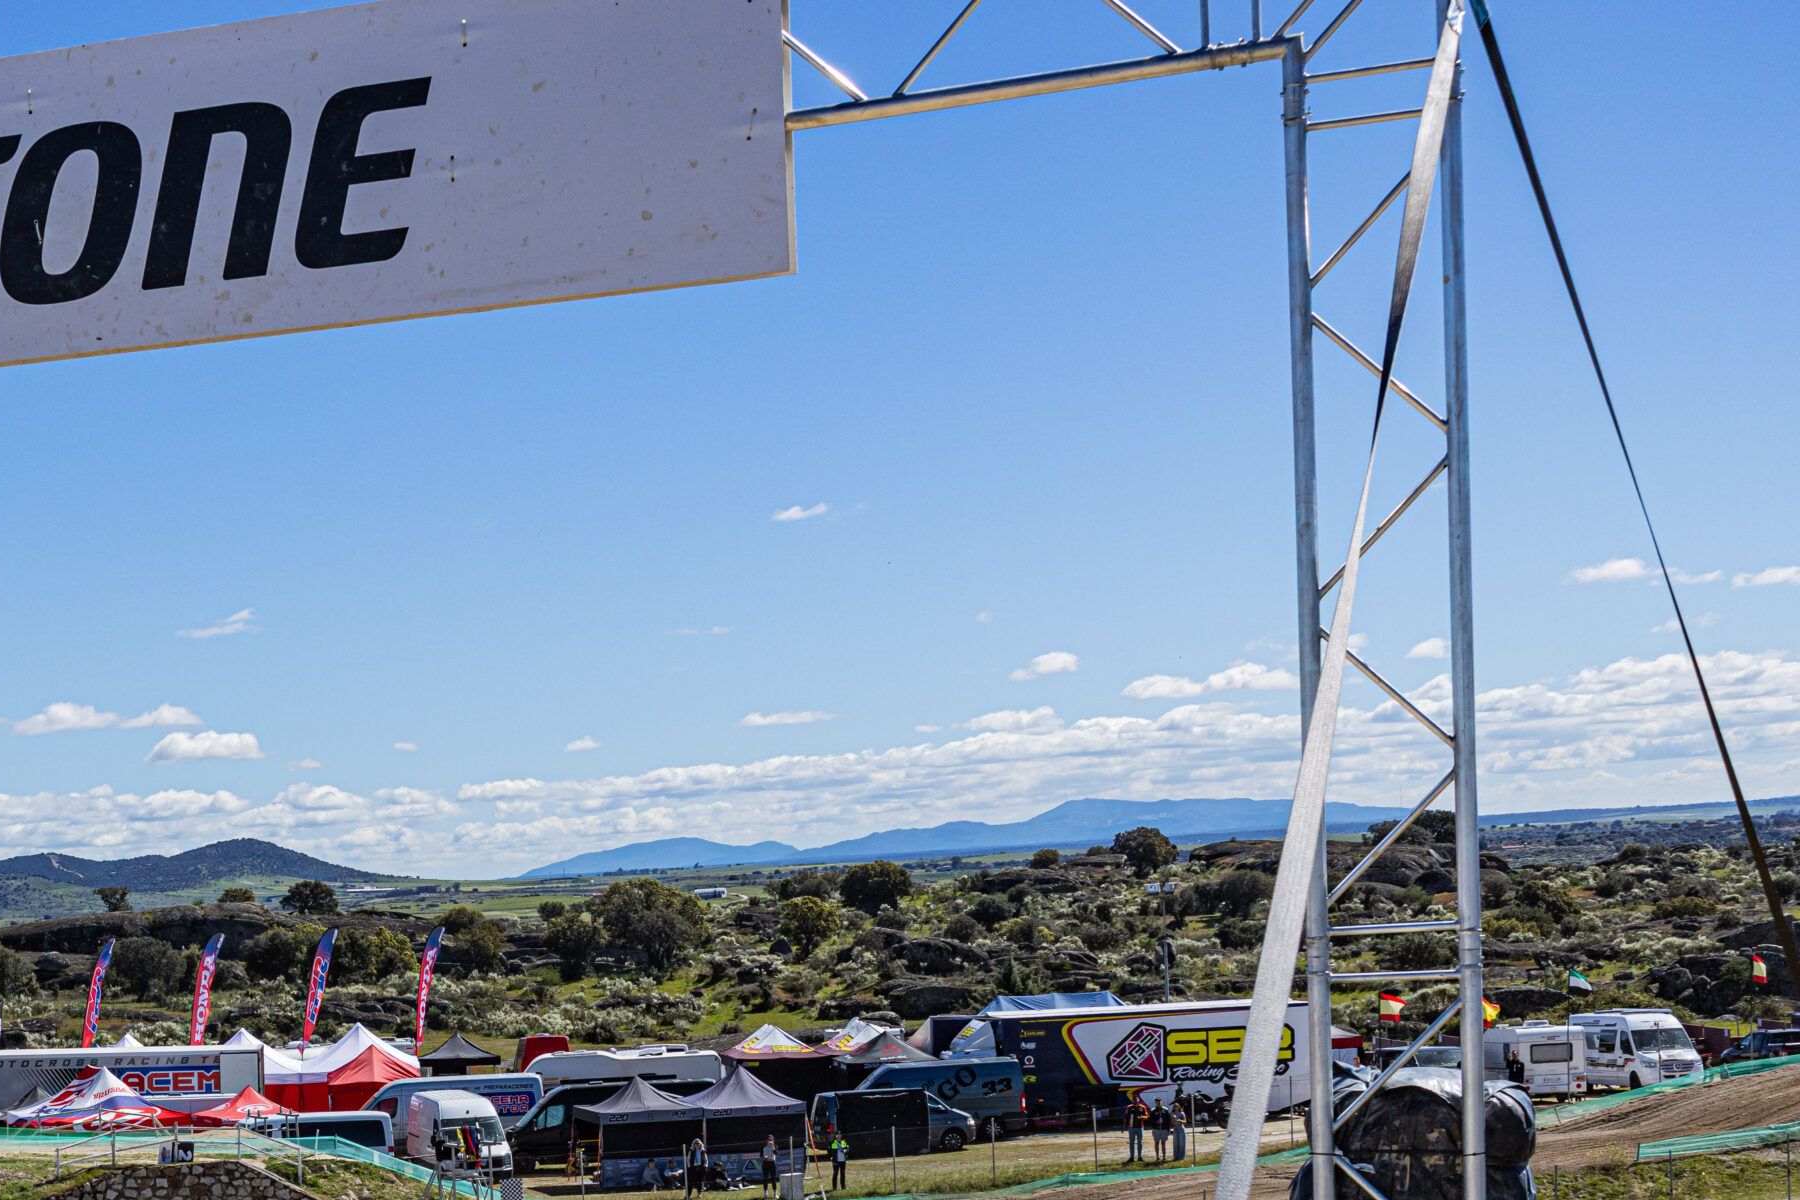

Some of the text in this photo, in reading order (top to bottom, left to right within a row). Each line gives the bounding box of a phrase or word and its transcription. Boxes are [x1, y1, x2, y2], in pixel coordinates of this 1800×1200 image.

[418, 947, 437, 1037] HONDA
[195, 953, 215, 1042] HONDA
[114, 1055, 190, 1065] RACING
[1174, 1065, 1224, 1079] Racing
[489, 1095, 529, 1103] CEMA
[713, 1108, 733, 1116] 220
[609, 1114, 629, 1122] 220
